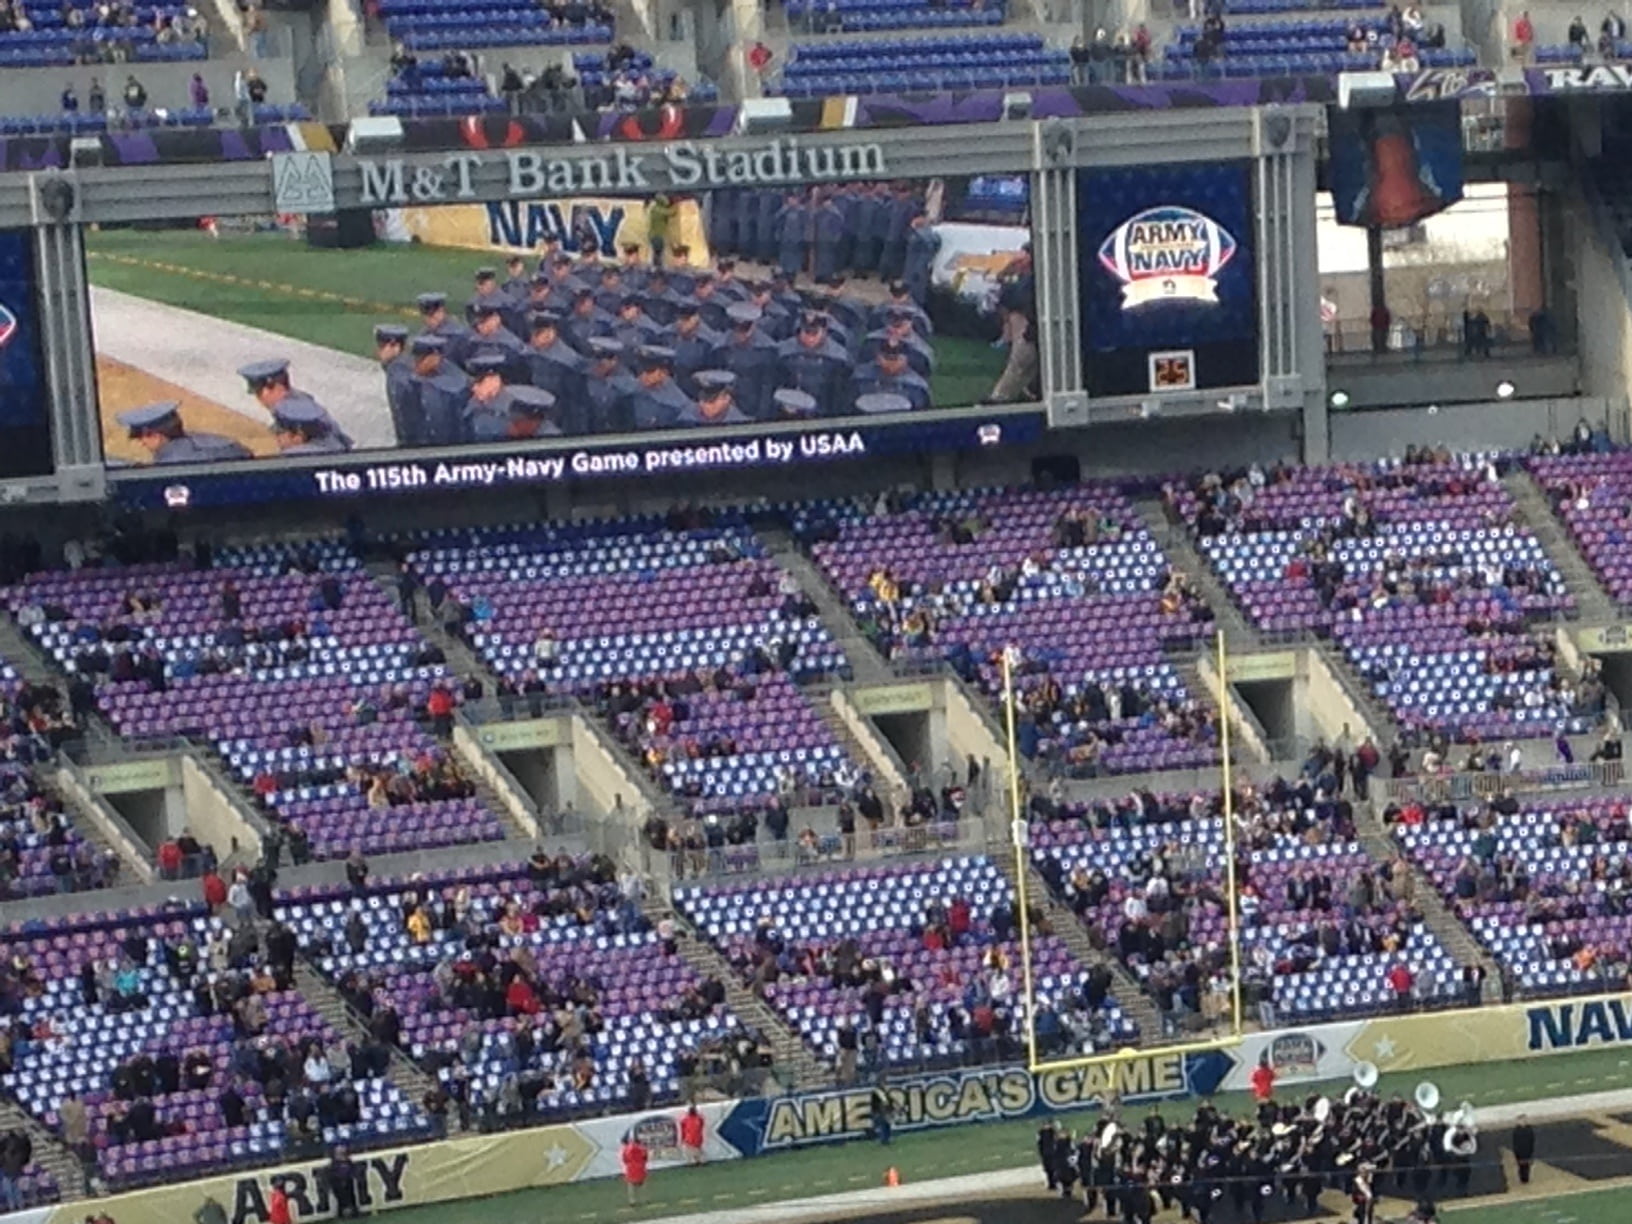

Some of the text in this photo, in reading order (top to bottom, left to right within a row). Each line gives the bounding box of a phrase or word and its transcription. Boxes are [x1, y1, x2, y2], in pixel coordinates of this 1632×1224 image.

[359, 140, 887, 201] M&T Bank Stadium
[484, 199, 628, 258] NAVY
[1132, 221, 1202, 244] ARMY
[1133, 249, 1201, 271] NAVY
[316, 432, 865, 493] The 115th Army-Navy Game presented by USAA
[1043, 1052, 1182, 1105] GAME
